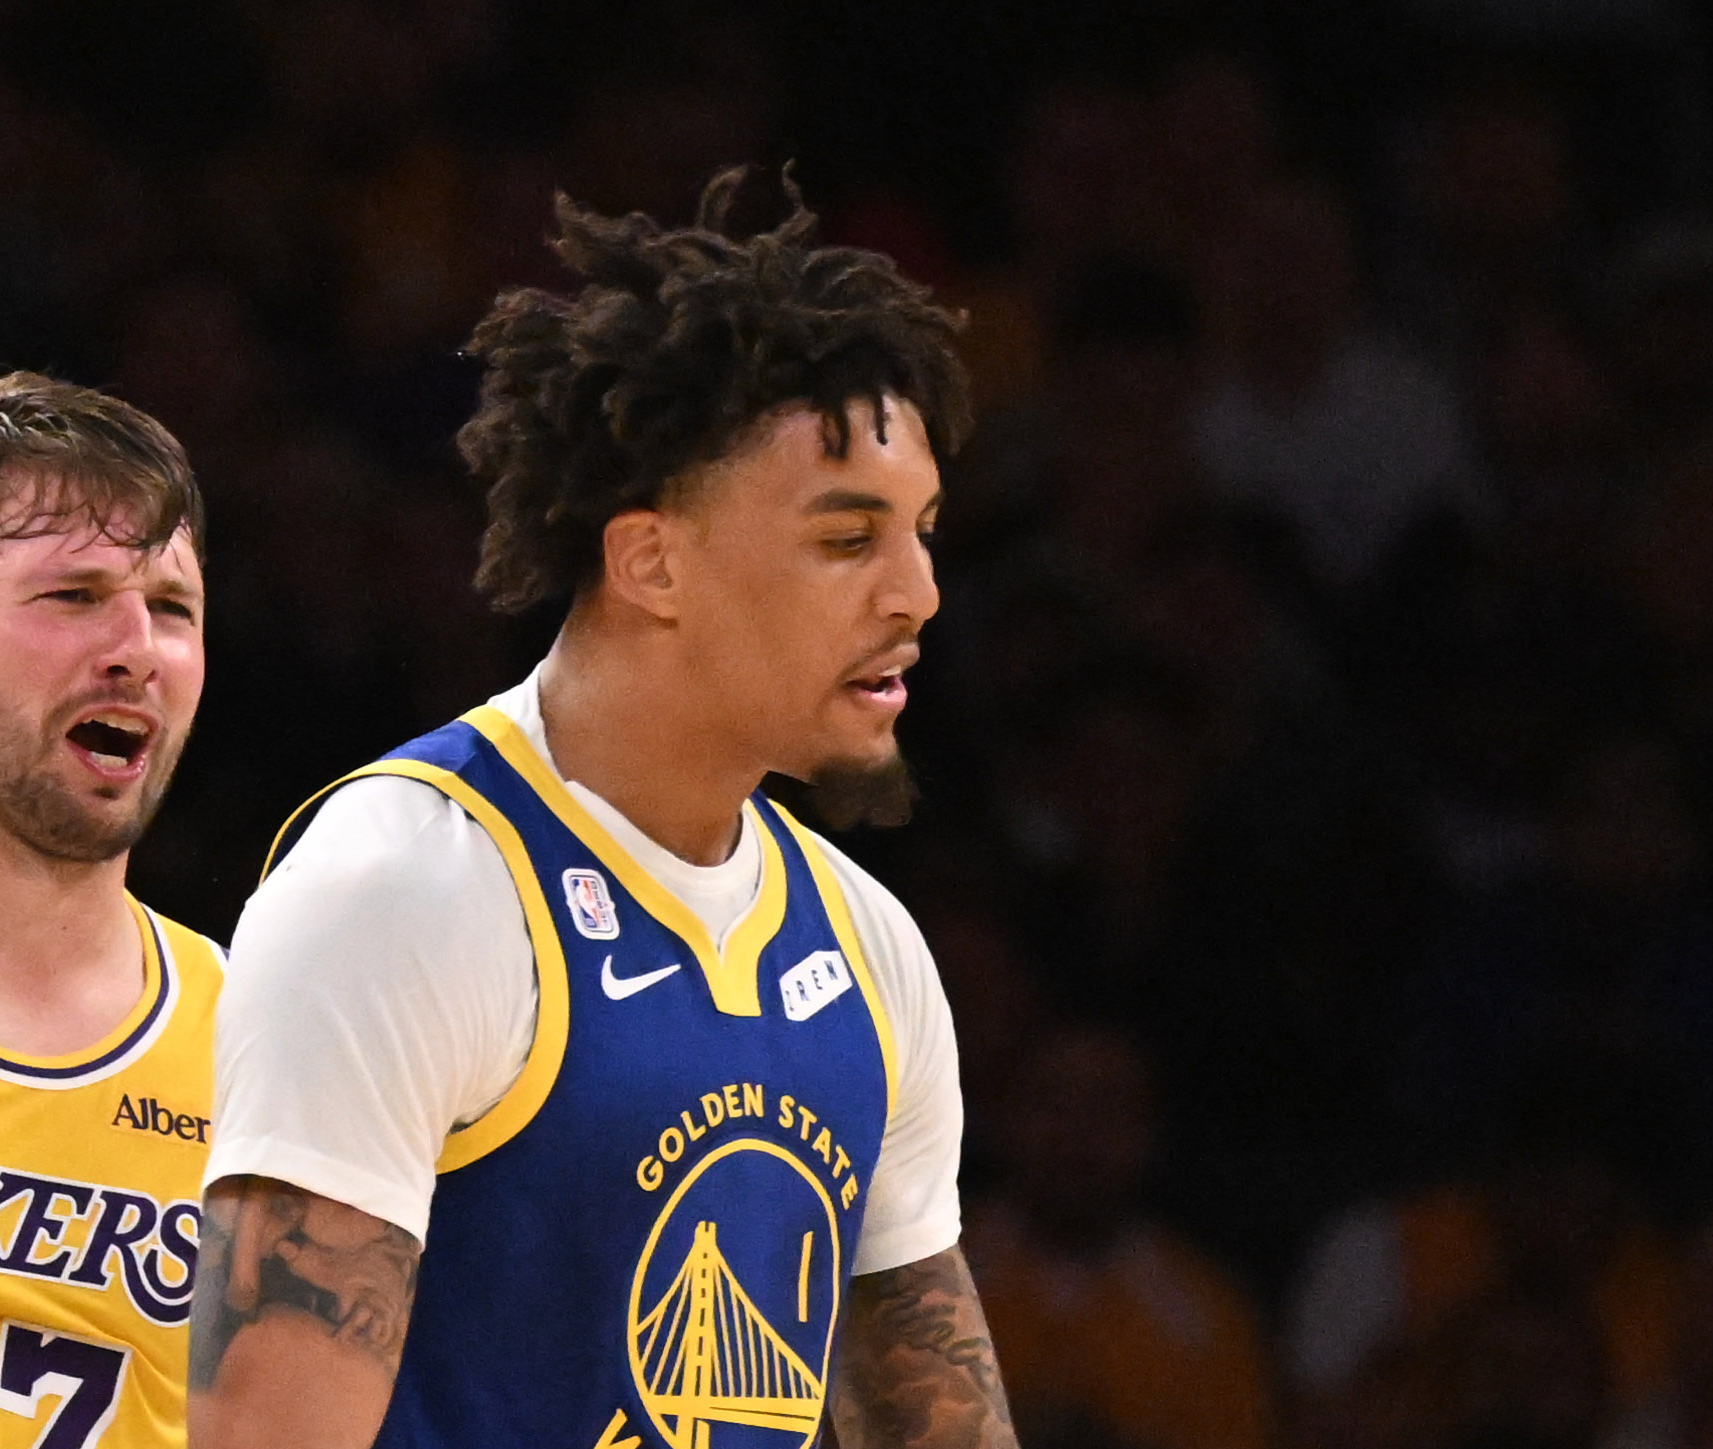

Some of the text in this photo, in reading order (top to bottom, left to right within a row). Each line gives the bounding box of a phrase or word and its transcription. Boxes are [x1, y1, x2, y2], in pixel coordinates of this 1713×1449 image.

[111, 1093, 212, 1145] Alber
[636, 1083, 858, 1211] GOLDEN STATE
[799, 1230, 814, 1323] 1
